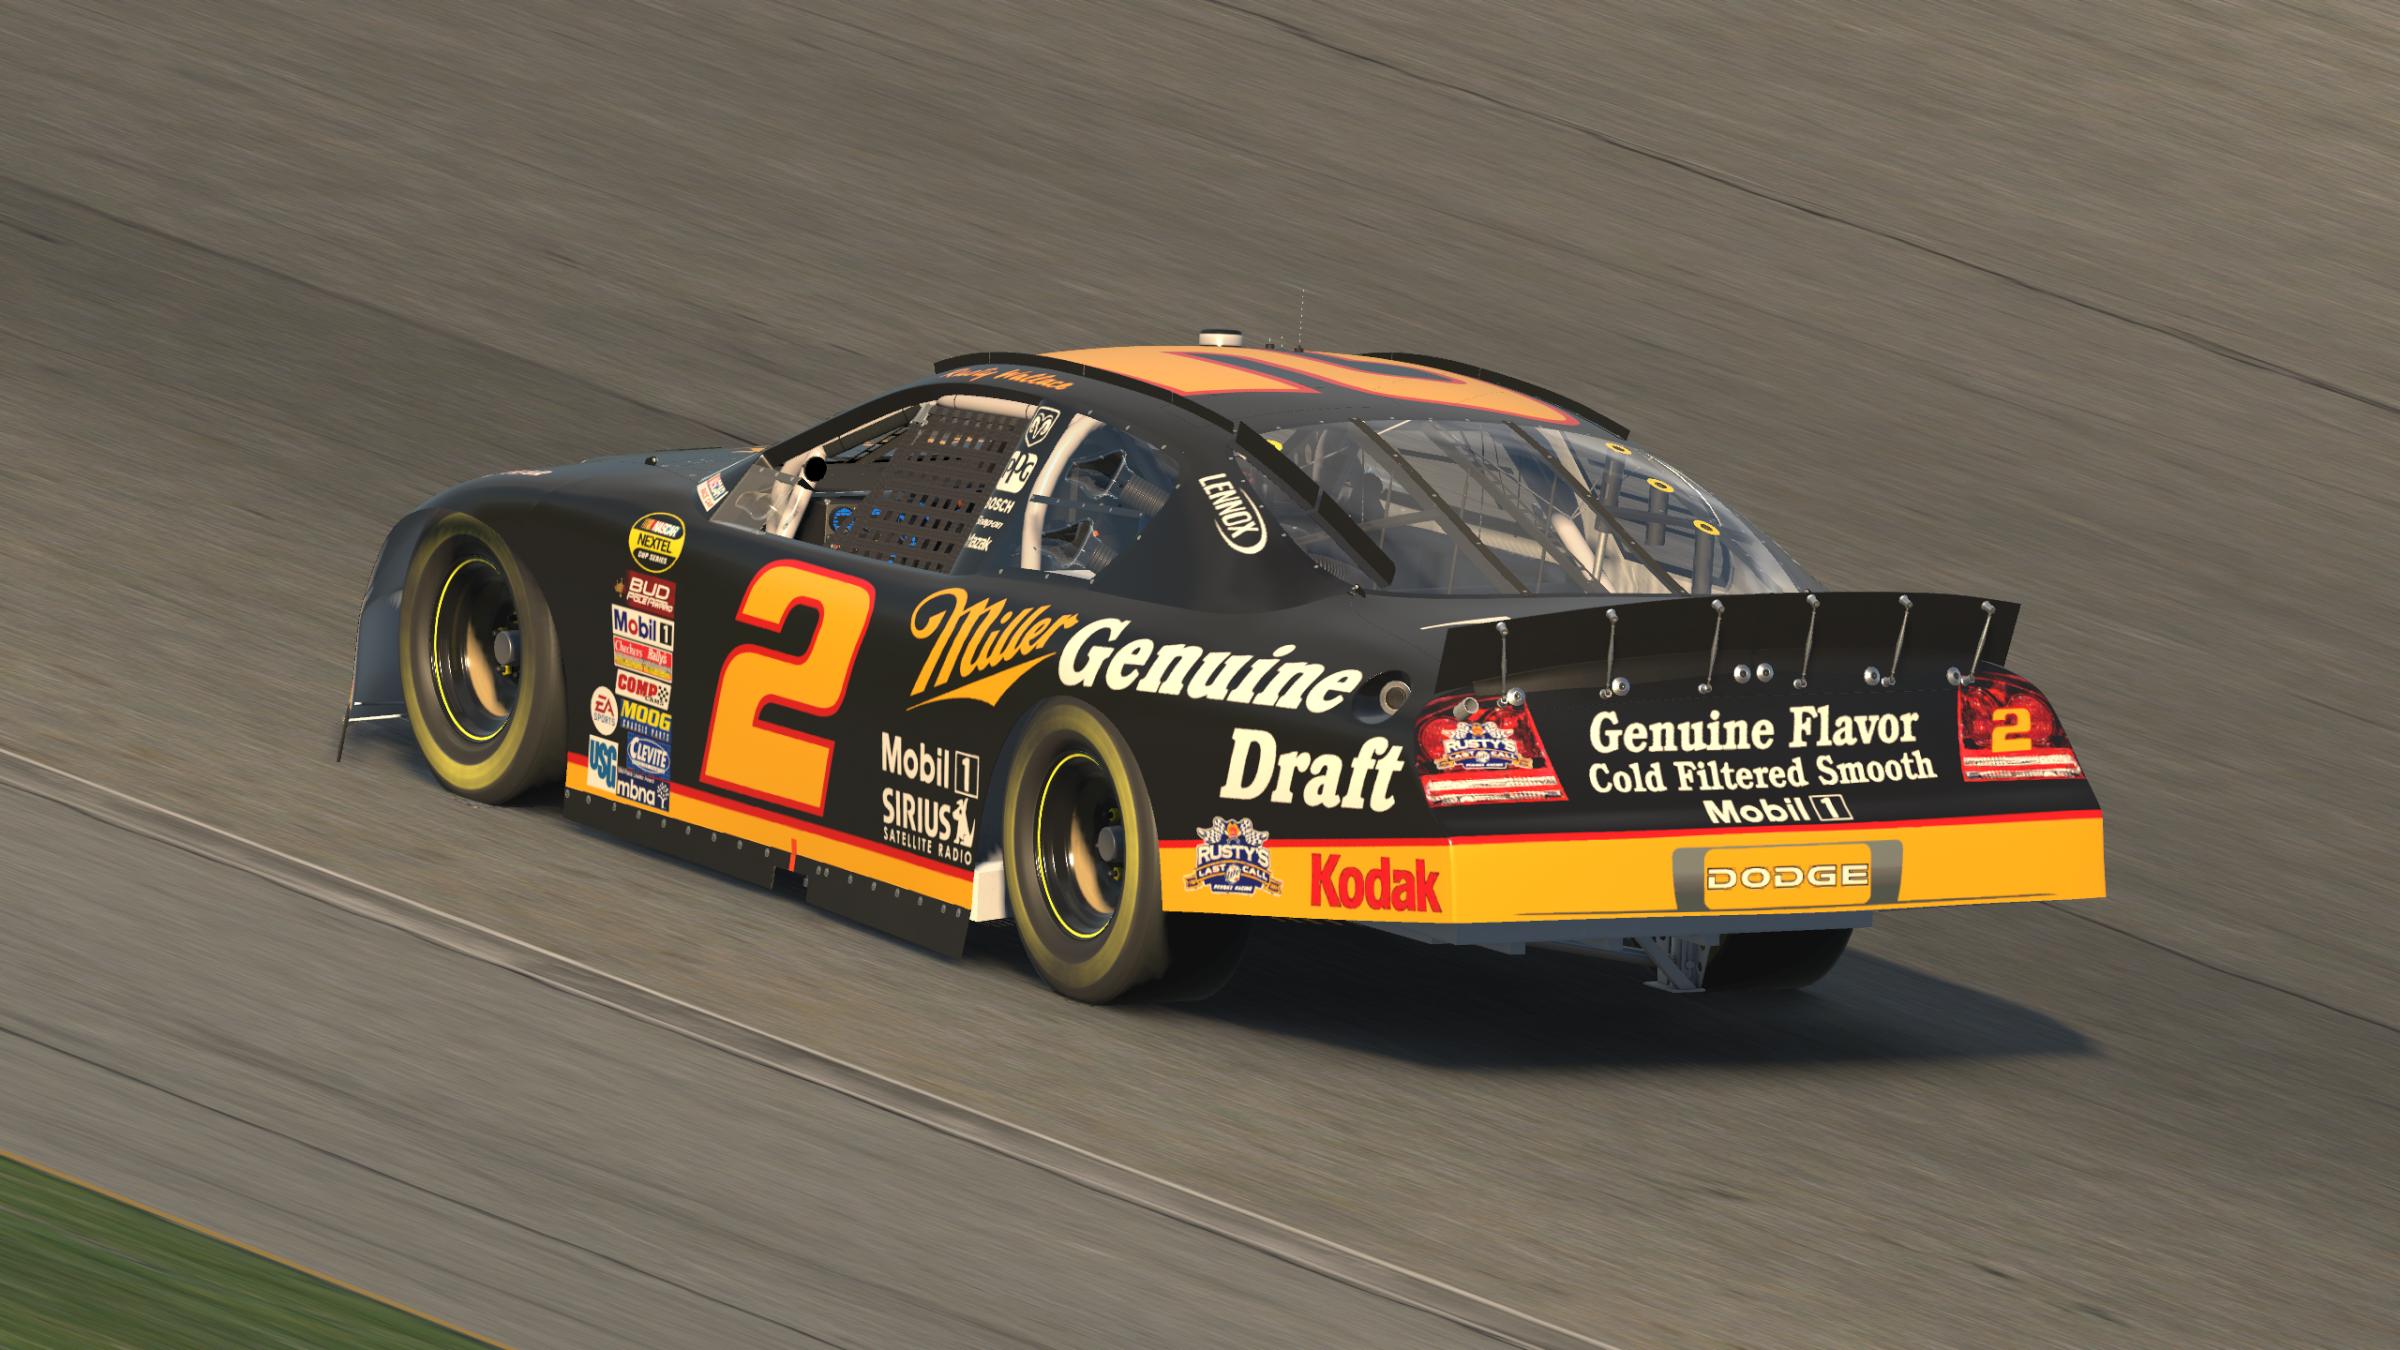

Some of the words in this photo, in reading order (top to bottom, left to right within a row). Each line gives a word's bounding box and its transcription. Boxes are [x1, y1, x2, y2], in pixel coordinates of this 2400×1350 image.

[993, 369, 1075, 390] Wallace
[1198, 472, 1260, 539] LENNOX
[637, 533, 672, 554] NEXTEL
[651, 520, 681, 538] NASCAR
[638, 551, 649, 560] CUP
[649, 553, 668, 565] SERIES
[628, 576, 671, 601] BUD
[613, 608, 657, 641] Mobil
[661, 623, 671, 645] 1
[910, 587, 1079, 697] Miller
[1058, 617, 1364, 714] Genuine
[617, 673, 658, 698] COMP
[699, 558, 876, 818] 2
[593, 712, 616, 727] SPORTS
[595, 694, 614, 717] EA
[621, 700, 672, 731] MOOG
[1589, 710, 1775, 754] Genuine
[1788, 704, 1920, 749] Flavor
[1991, 707, 2032, 753] 2
[629, 736, 667, 769] CLEVITE
[881, 731, 950, 790] Mobil
[1446, 739, 1517, 754] RUSTY'S
[590, 739, 618, 790] USG
[1219, 728, 1405, 813] Draft
[1589, 762, 1668, 793] Cold
[1673, 756, 1809, 791] Filtered
[1815, 749, 1938, 786] Smooth
[617, 778, 656, 806] mbna
[882, 787, 952, 841] SIRIUS
[1703, 797, 1812, 824] Mobil
[883, 826, 932, 854] SATELLITE
[938, 843, 973, 866] RADIO
[1198, 844, 1270, 869] RUSTY'S
[1199, 864, 1226, 877] LAST
[1242, 865, 1268, 881] CALL
[1311, 853, 1442, 913] Kodak
[1706, 863, 1869, 890] DODGE
